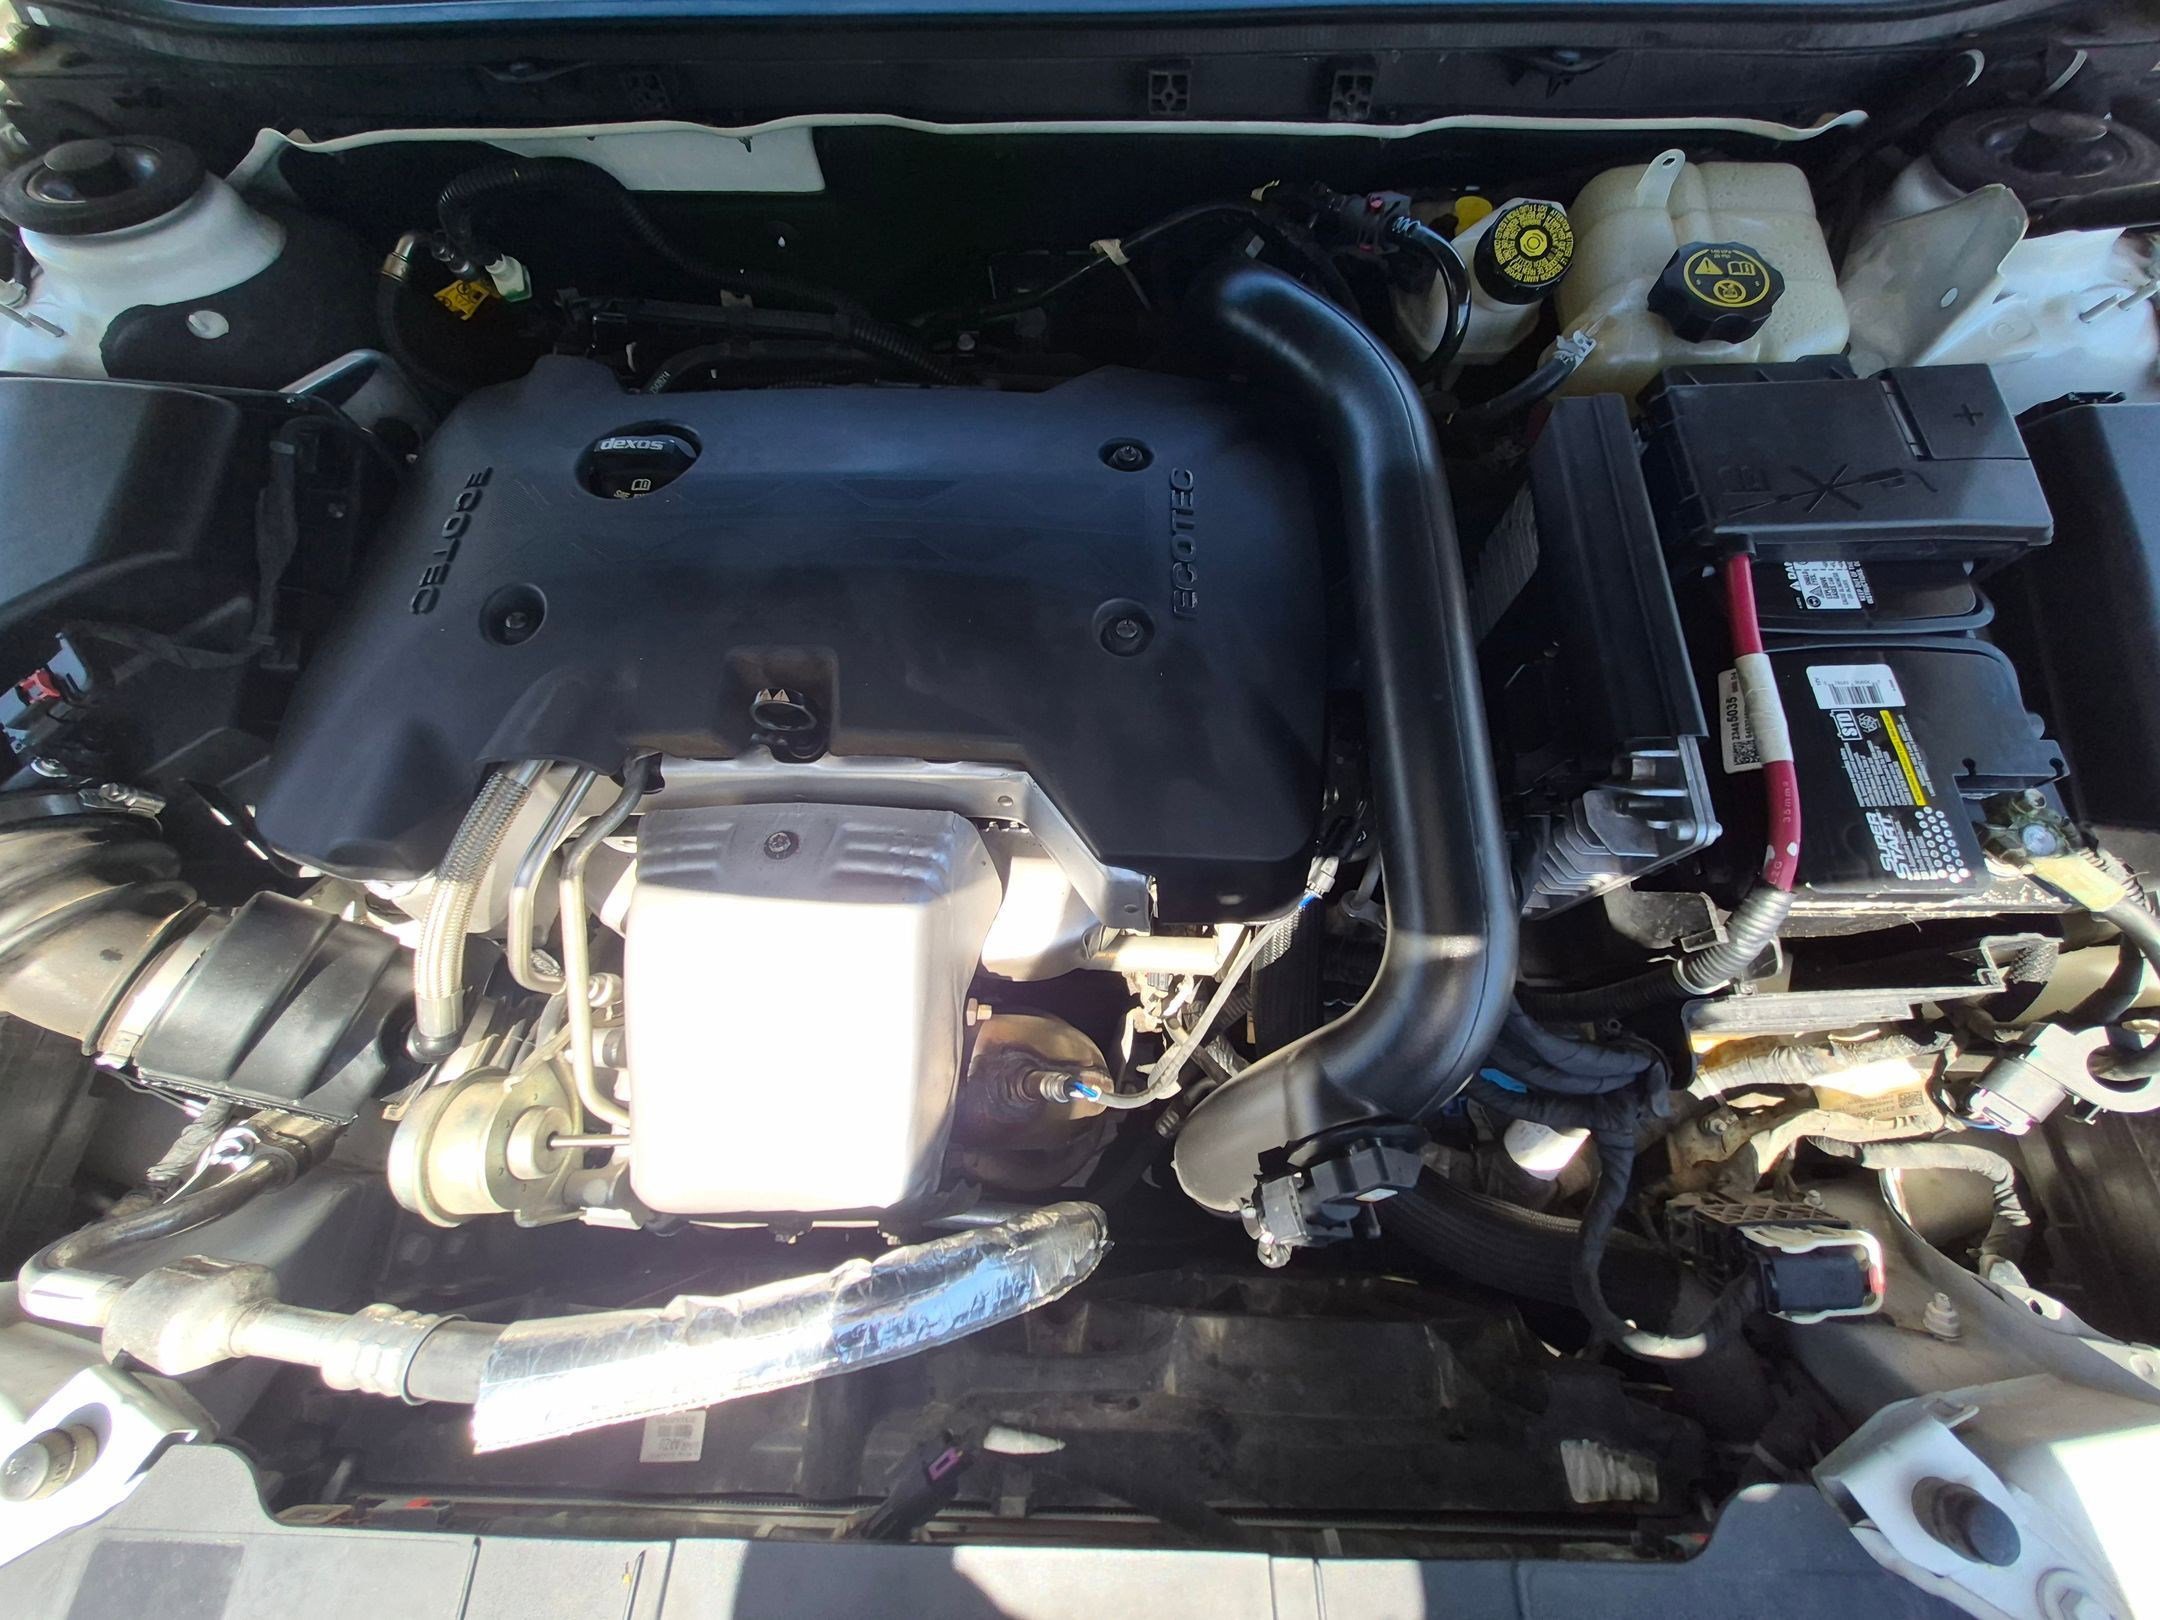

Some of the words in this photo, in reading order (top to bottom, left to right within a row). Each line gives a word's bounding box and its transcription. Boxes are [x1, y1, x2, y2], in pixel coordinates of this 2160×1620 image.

[600, 437, 665, 450] dexos
[409, 466, 494, 615] ECOTEC
[1170, 467, 1199, 617] ECOTEC
[1865, 811, 1892, 871] SUPER
[1875, 811, 1914, 880] START
